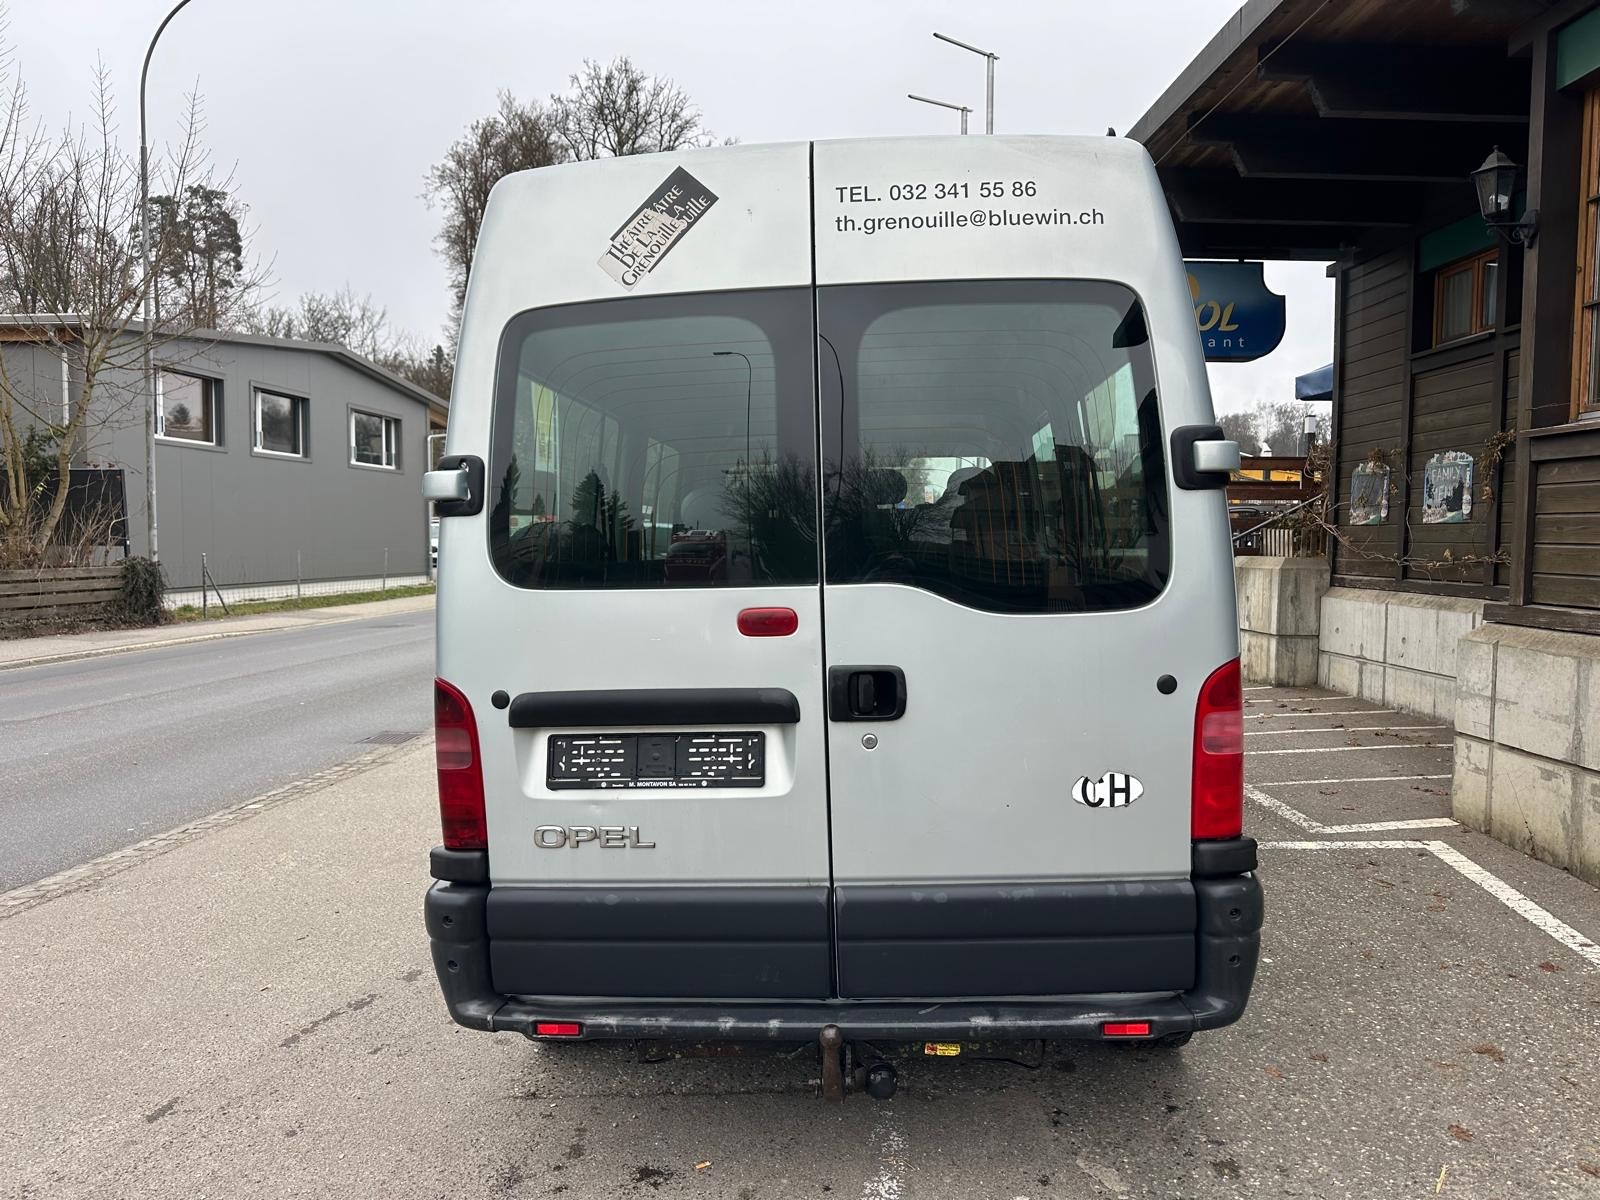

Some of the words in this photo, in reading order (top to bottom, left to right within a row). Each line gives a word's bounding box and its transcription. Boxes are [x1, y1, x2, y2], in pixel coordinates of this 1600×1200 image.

[835, 186, 882, 203] TEL.
[889, 184, 927, 201] 032
[934, 183, 970, 200] 341
[979, 181, 1005, 198] 55
[1011, 181, 1037, 198] 86
[835, 208, 1105, 235] th.grenouille@bluewin.ch
[619, 246, 643, 270] DE
[636, 230, 658, 249] LA
[1195, 301, 1239, 331] OL
[1208, 337, 1246, 348] ant
[1431, 465, 1461, 482] FAMILY
[1081, 774, 1130, 807] CH
[533, 825, 656, 848] OPEL
